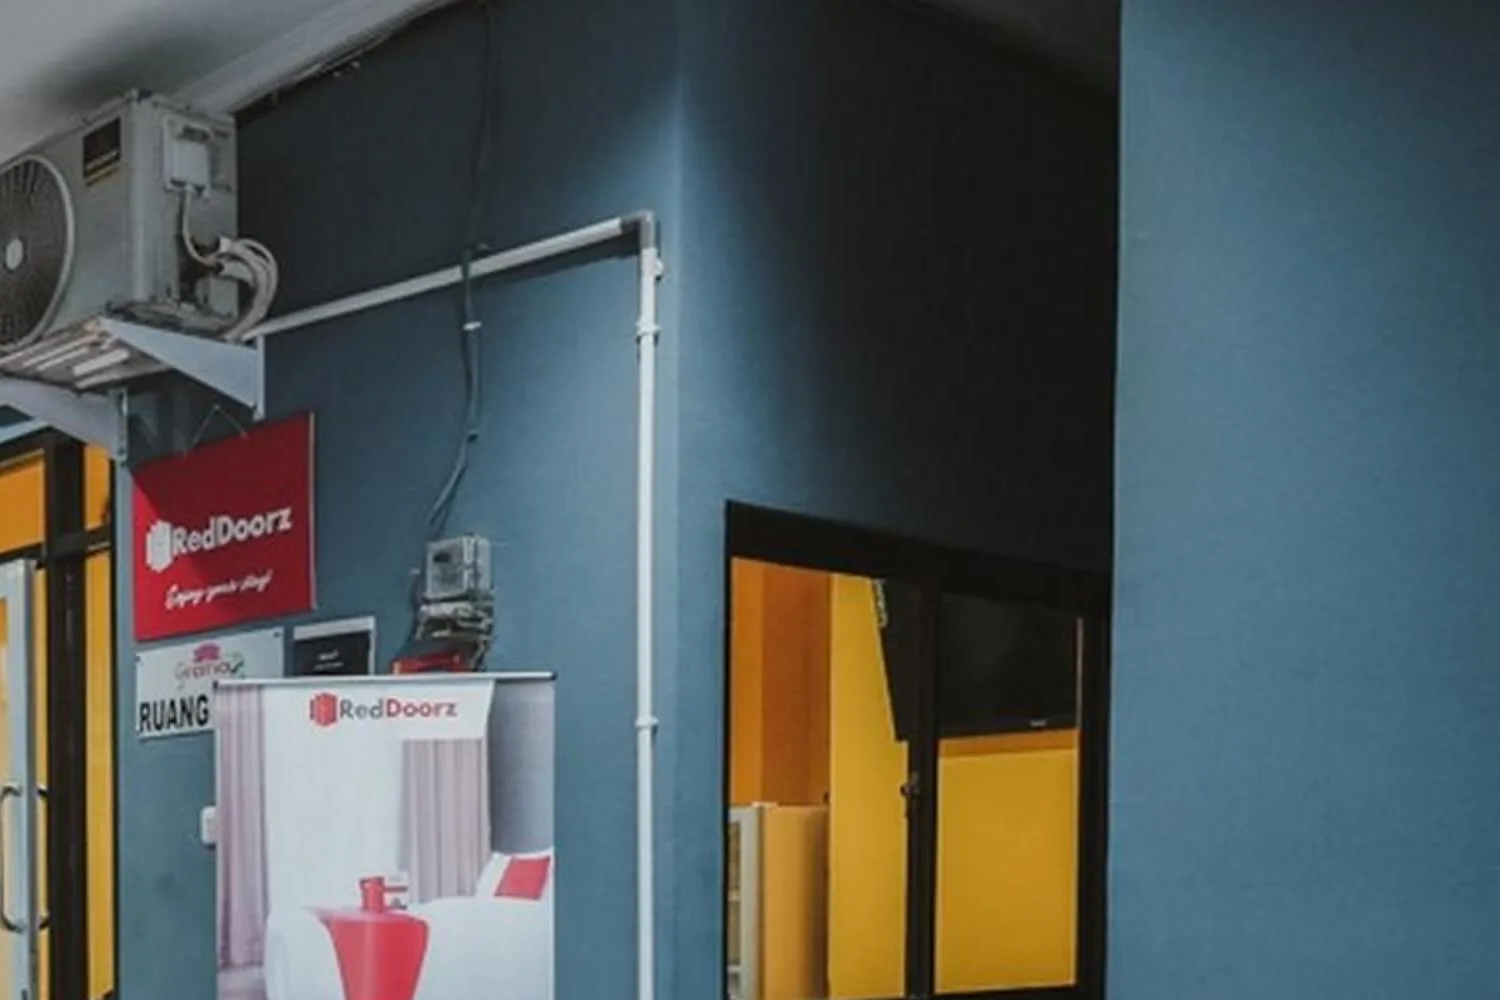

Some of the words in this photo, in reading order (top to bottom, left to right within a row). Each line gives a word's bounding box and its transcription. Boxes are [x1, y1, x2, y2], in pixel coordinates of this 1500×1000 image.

[171, 506, 293, 556] RedDoorz
[139, 692, 210, 731] RUANG
[339, 697, 457, 720] RedDoorz
